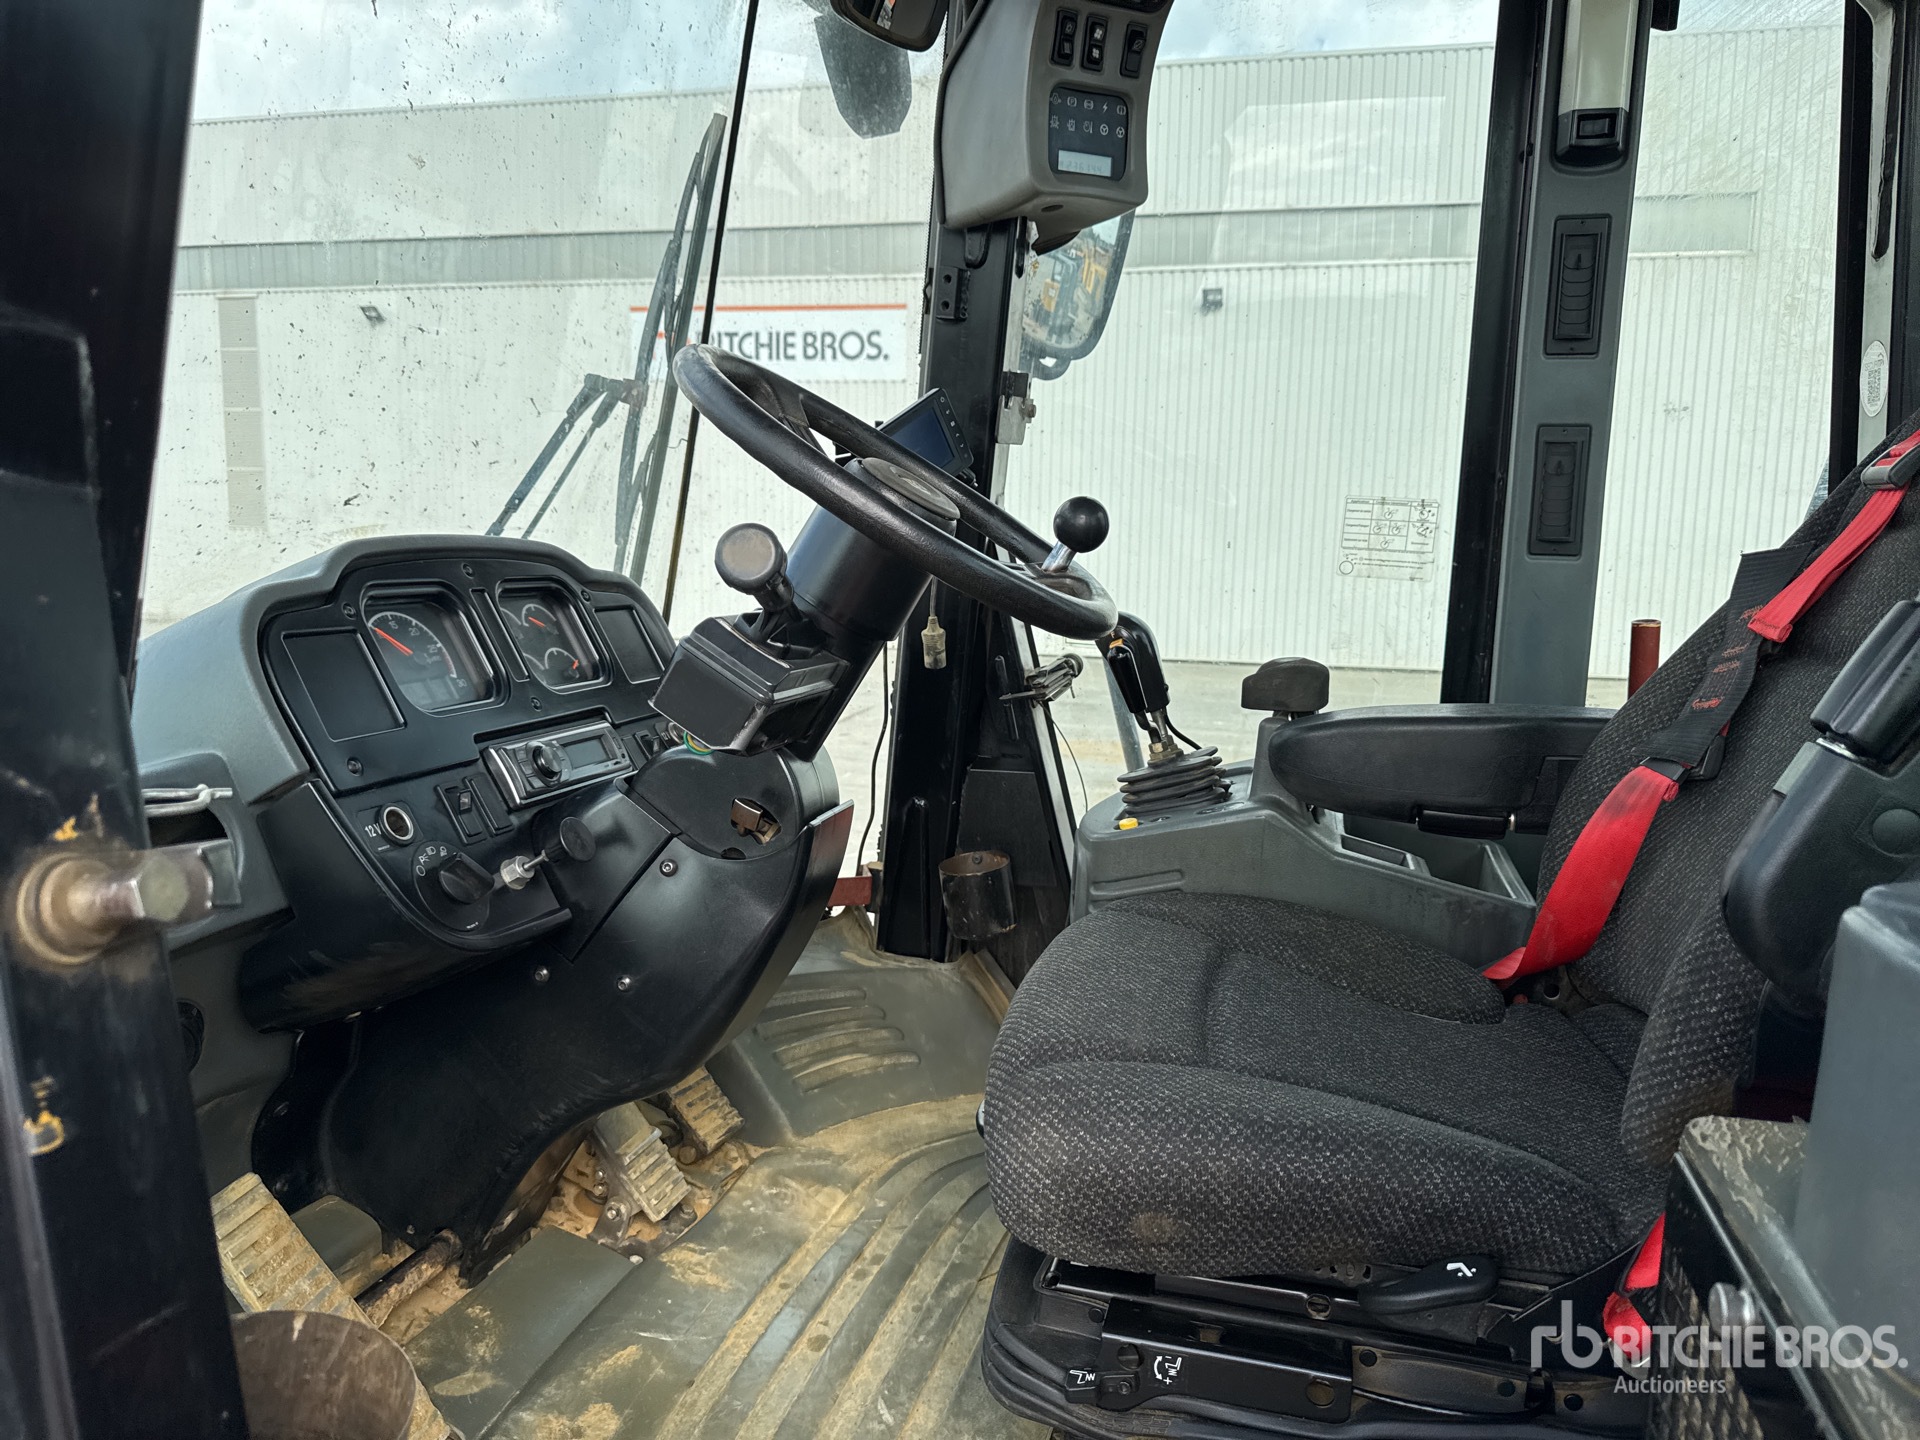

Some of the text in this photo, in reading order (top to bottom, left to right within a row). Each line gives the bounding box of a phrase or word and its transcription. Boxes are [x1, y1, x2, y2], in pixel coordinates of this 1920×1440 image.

[803, 330, 889, 361] BROS.
[408, 627, 420, 636] 20
[364, 823, 382, 838] 12V
